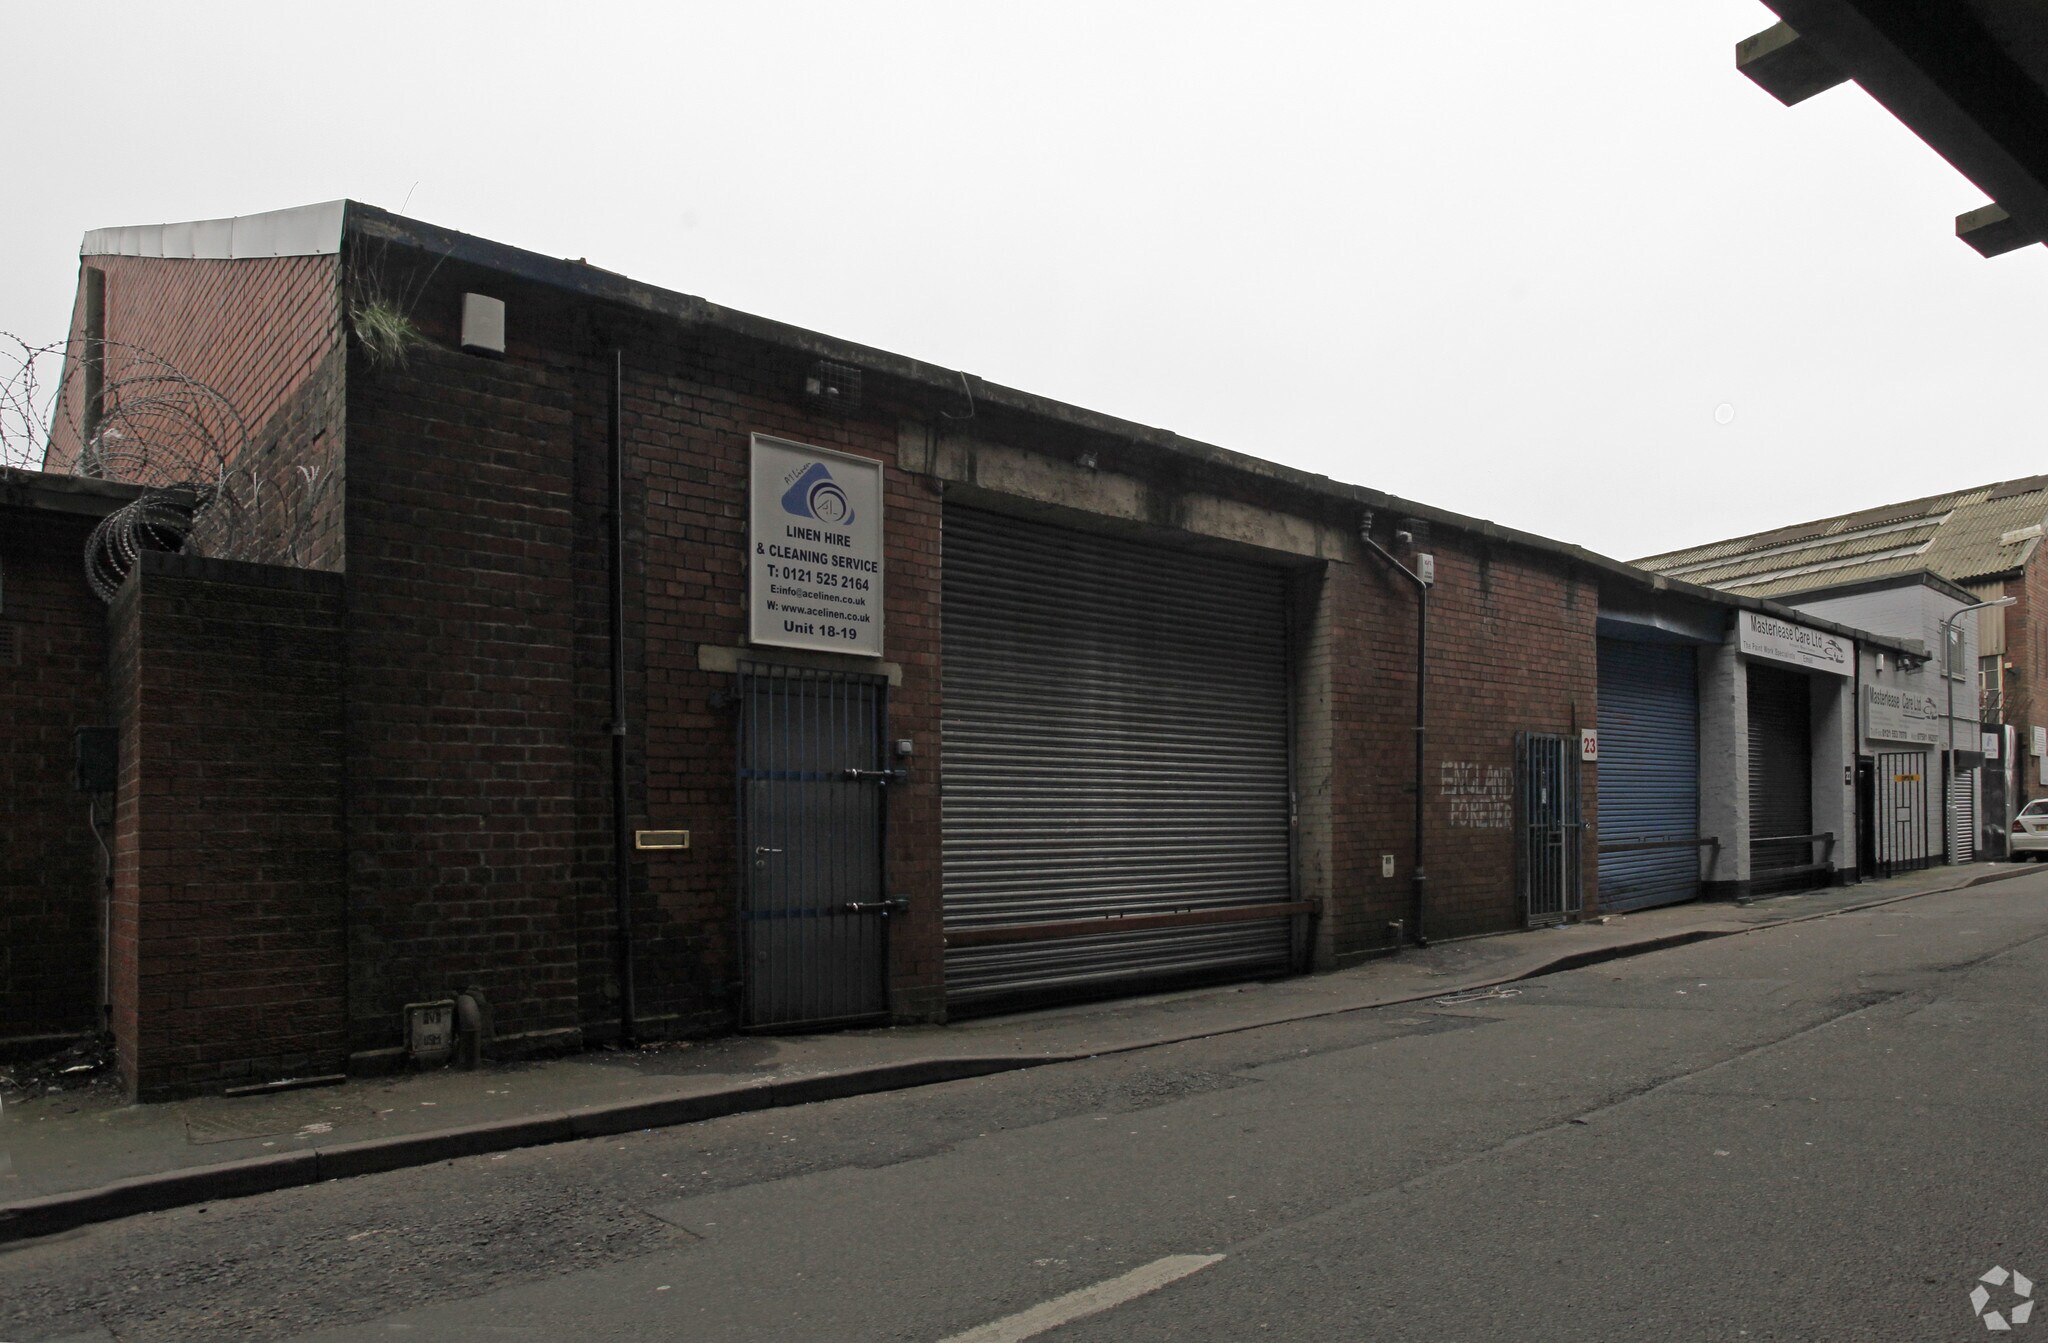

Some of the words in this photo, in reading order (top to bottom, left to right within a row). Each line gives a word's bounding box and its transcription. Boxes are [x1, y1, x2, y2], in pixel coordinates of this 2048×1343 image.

[787, 525, 820, 542] LINEN
[825, 532, 851, 547] HIRE
[757, 542, 765, 554] &
[769, 544, 828, 565] CLEANING
[832, 555, 878, 573] SERVICE
[767, 564, 779, 577] T:
[783, 567, 811, 582] 0121
[816, 572, 837, 586] 525
[841, 576, 869, 591] 2164
[767, 600, 779, 610] W:
[781, 604, 870, 622] www.acelinen.co.uk
[784, 620, 814, 634] Unit
[819, 625, 857, 639] 18-19
[1750, 615, 1793, 640] Masterlease
[1794, 627, 1810, 645] Care
[1812, 633, 1822, 648] Ltd
[1902, 693, 1913, 710] Care
[1584, 737, 1596, 753] 23
[1440, 761, 1514, 800] ENGLAND
[1450, 798, 1512, 831] FOREVER
